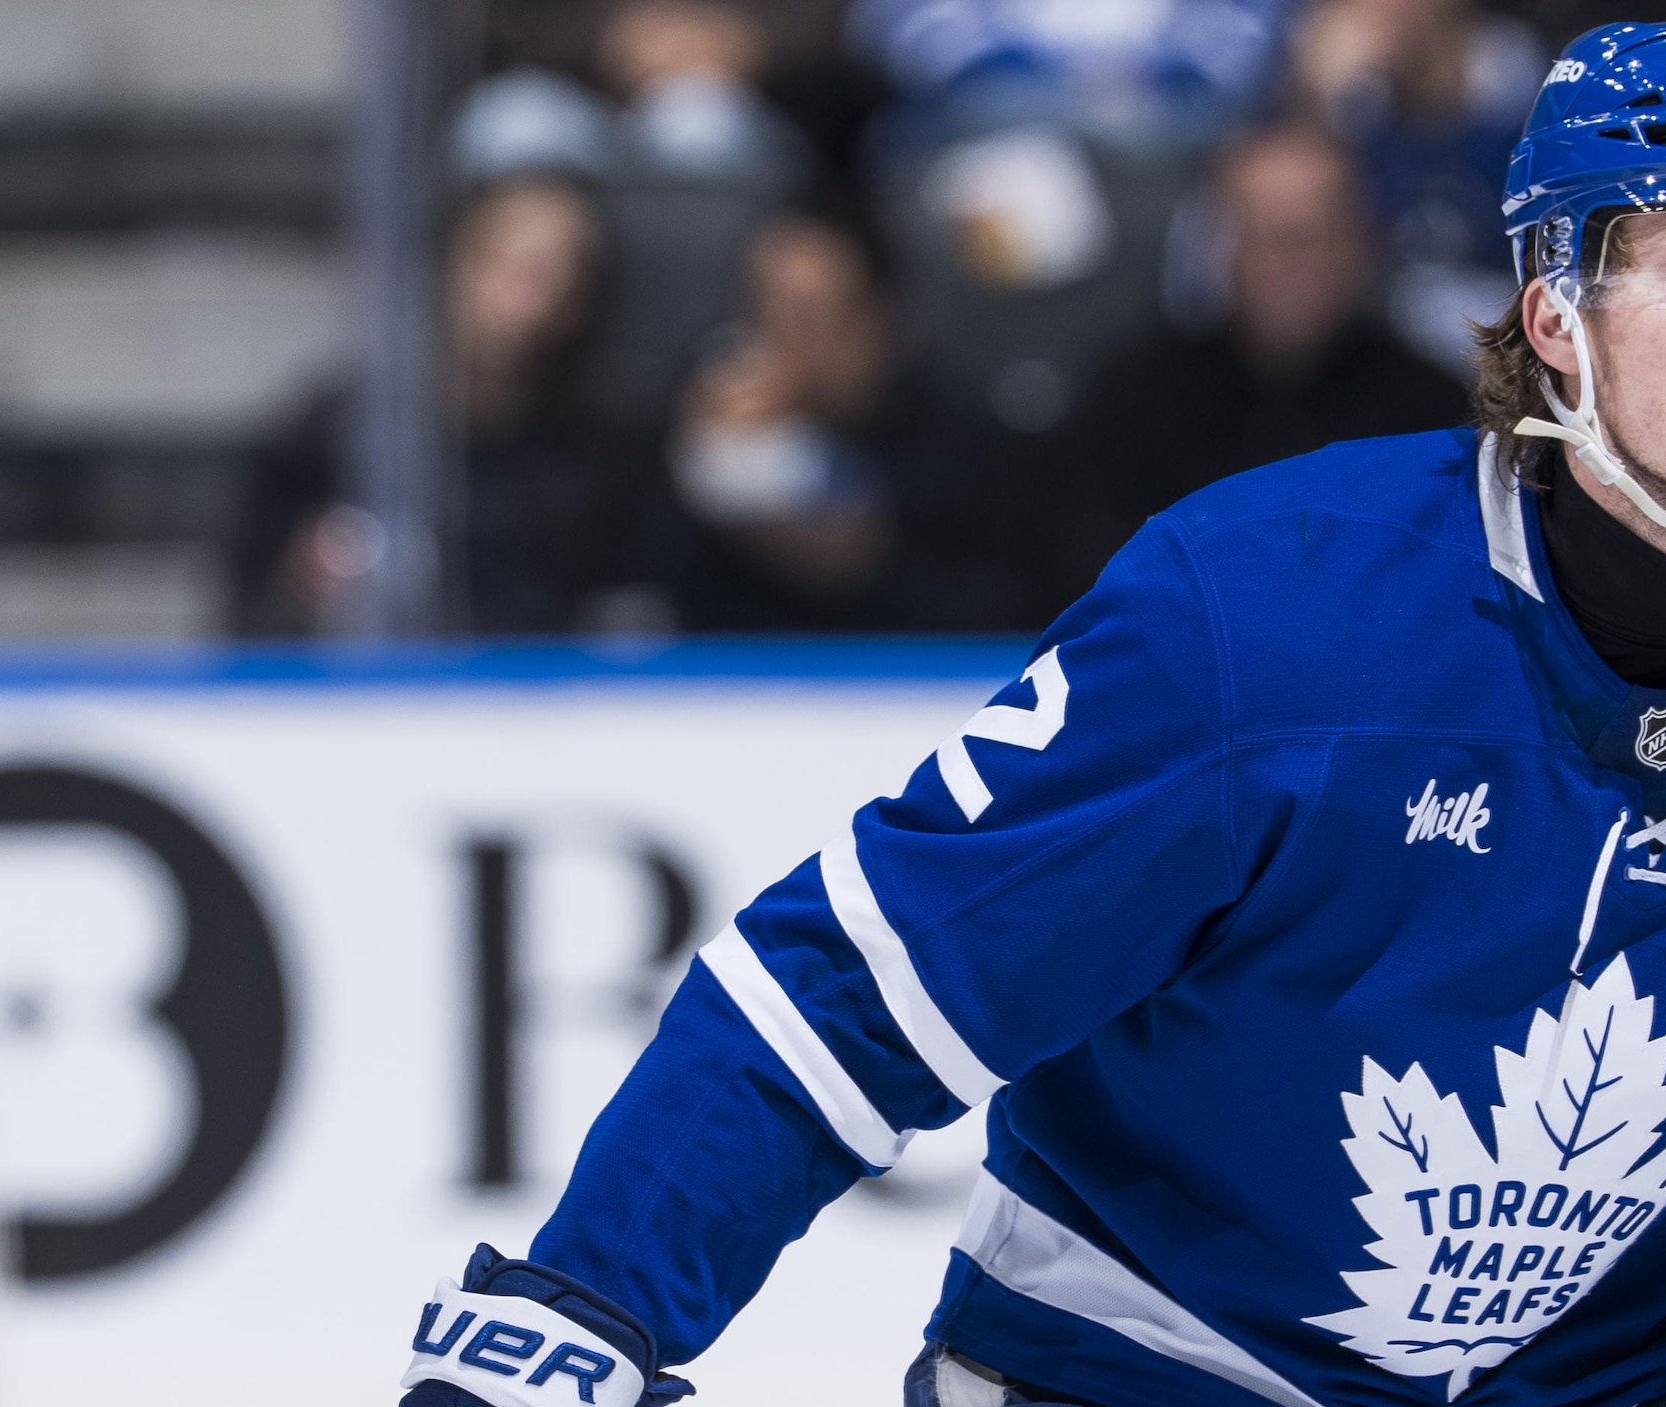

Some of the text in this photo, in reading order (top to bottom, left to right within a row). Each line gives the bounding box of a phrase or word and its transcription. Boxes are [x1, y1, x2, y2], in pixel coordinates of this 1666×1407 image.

[936, 645, 1070, 825] 2
[1405, 778, 1492, 854] Milk
[1404, 1180, 1656, 1242] TORONTO
[1428, 1236, 1607, 1282] MAPLE
[1407, 1282, 1580, 1326] LEAFS
